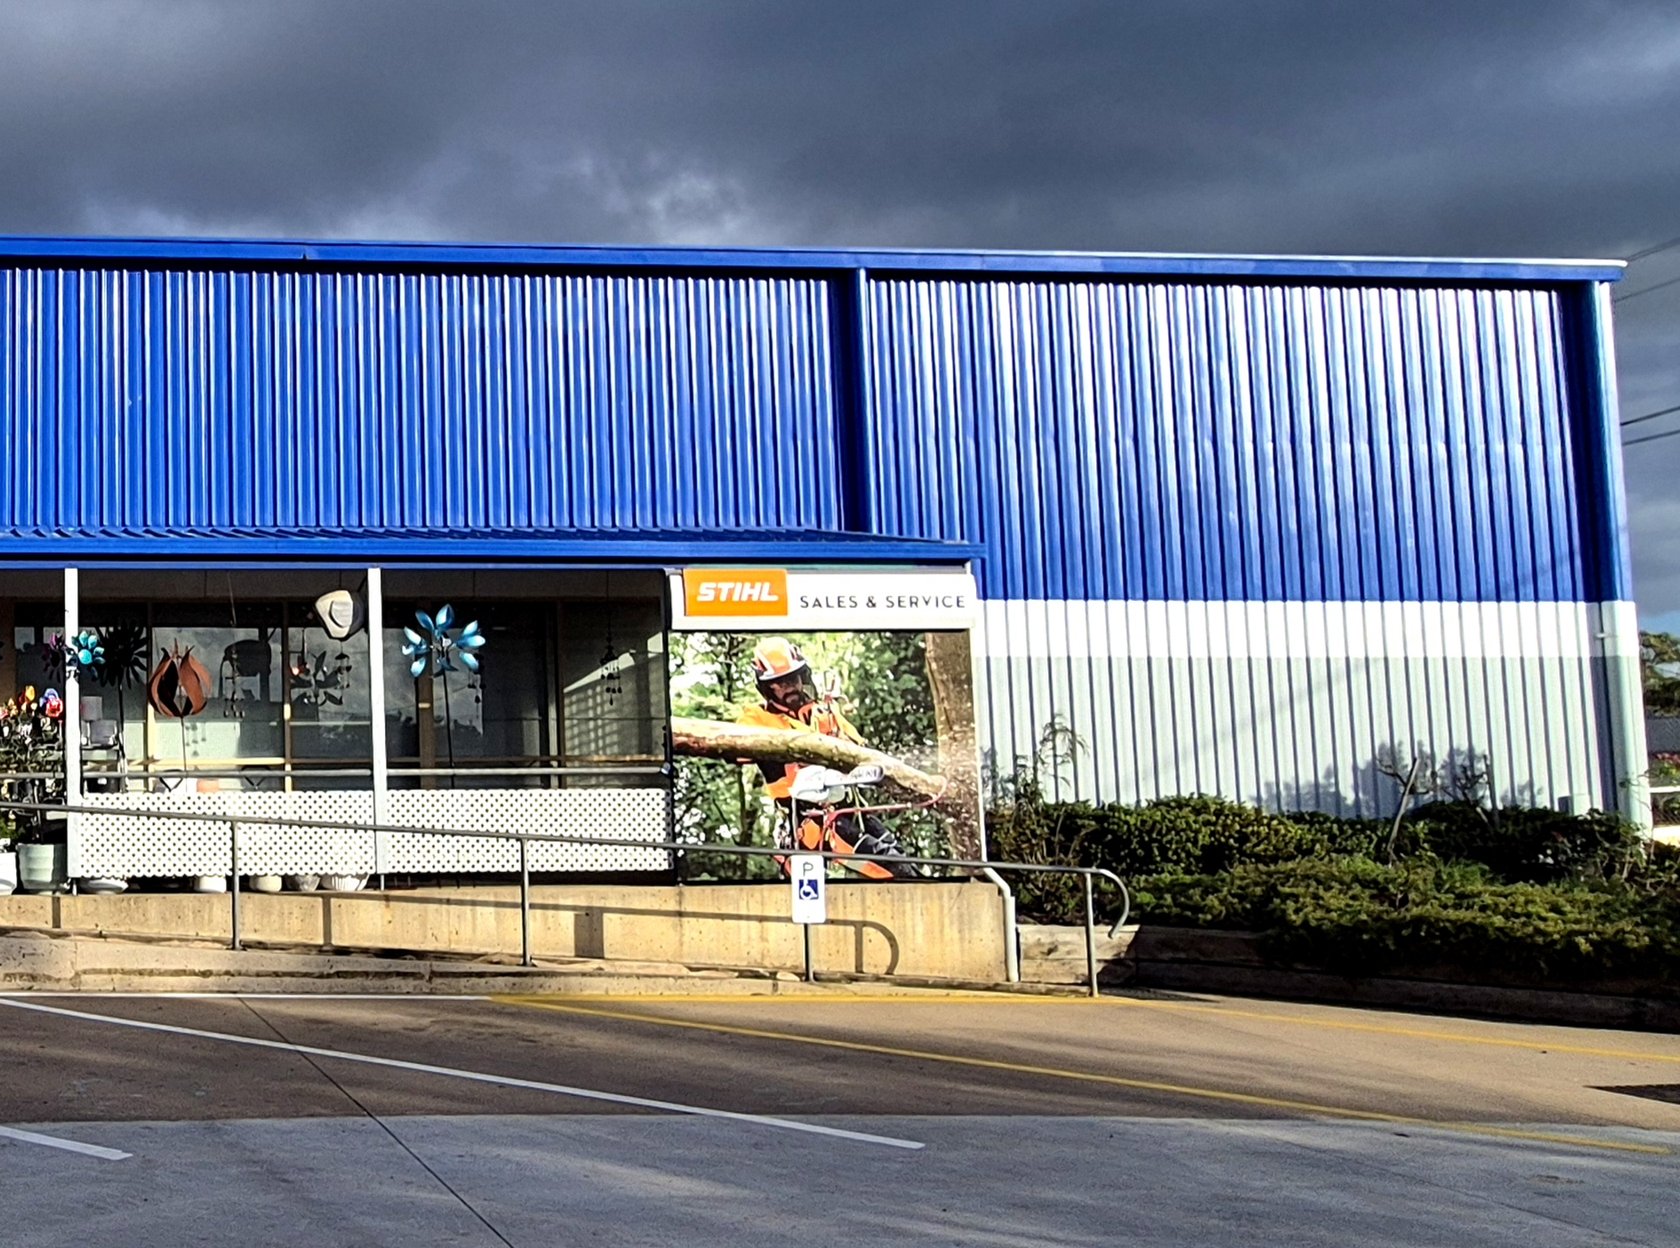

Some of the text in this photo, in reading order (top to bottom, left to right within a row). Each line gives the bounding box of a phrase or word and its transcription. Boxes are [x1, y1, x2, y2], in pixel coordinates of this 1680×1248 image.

[697, 582, 779, 602] STIHL
[800, 595, 966, 609] SALES & SERVICE
[802, 862, 814, 875] P
